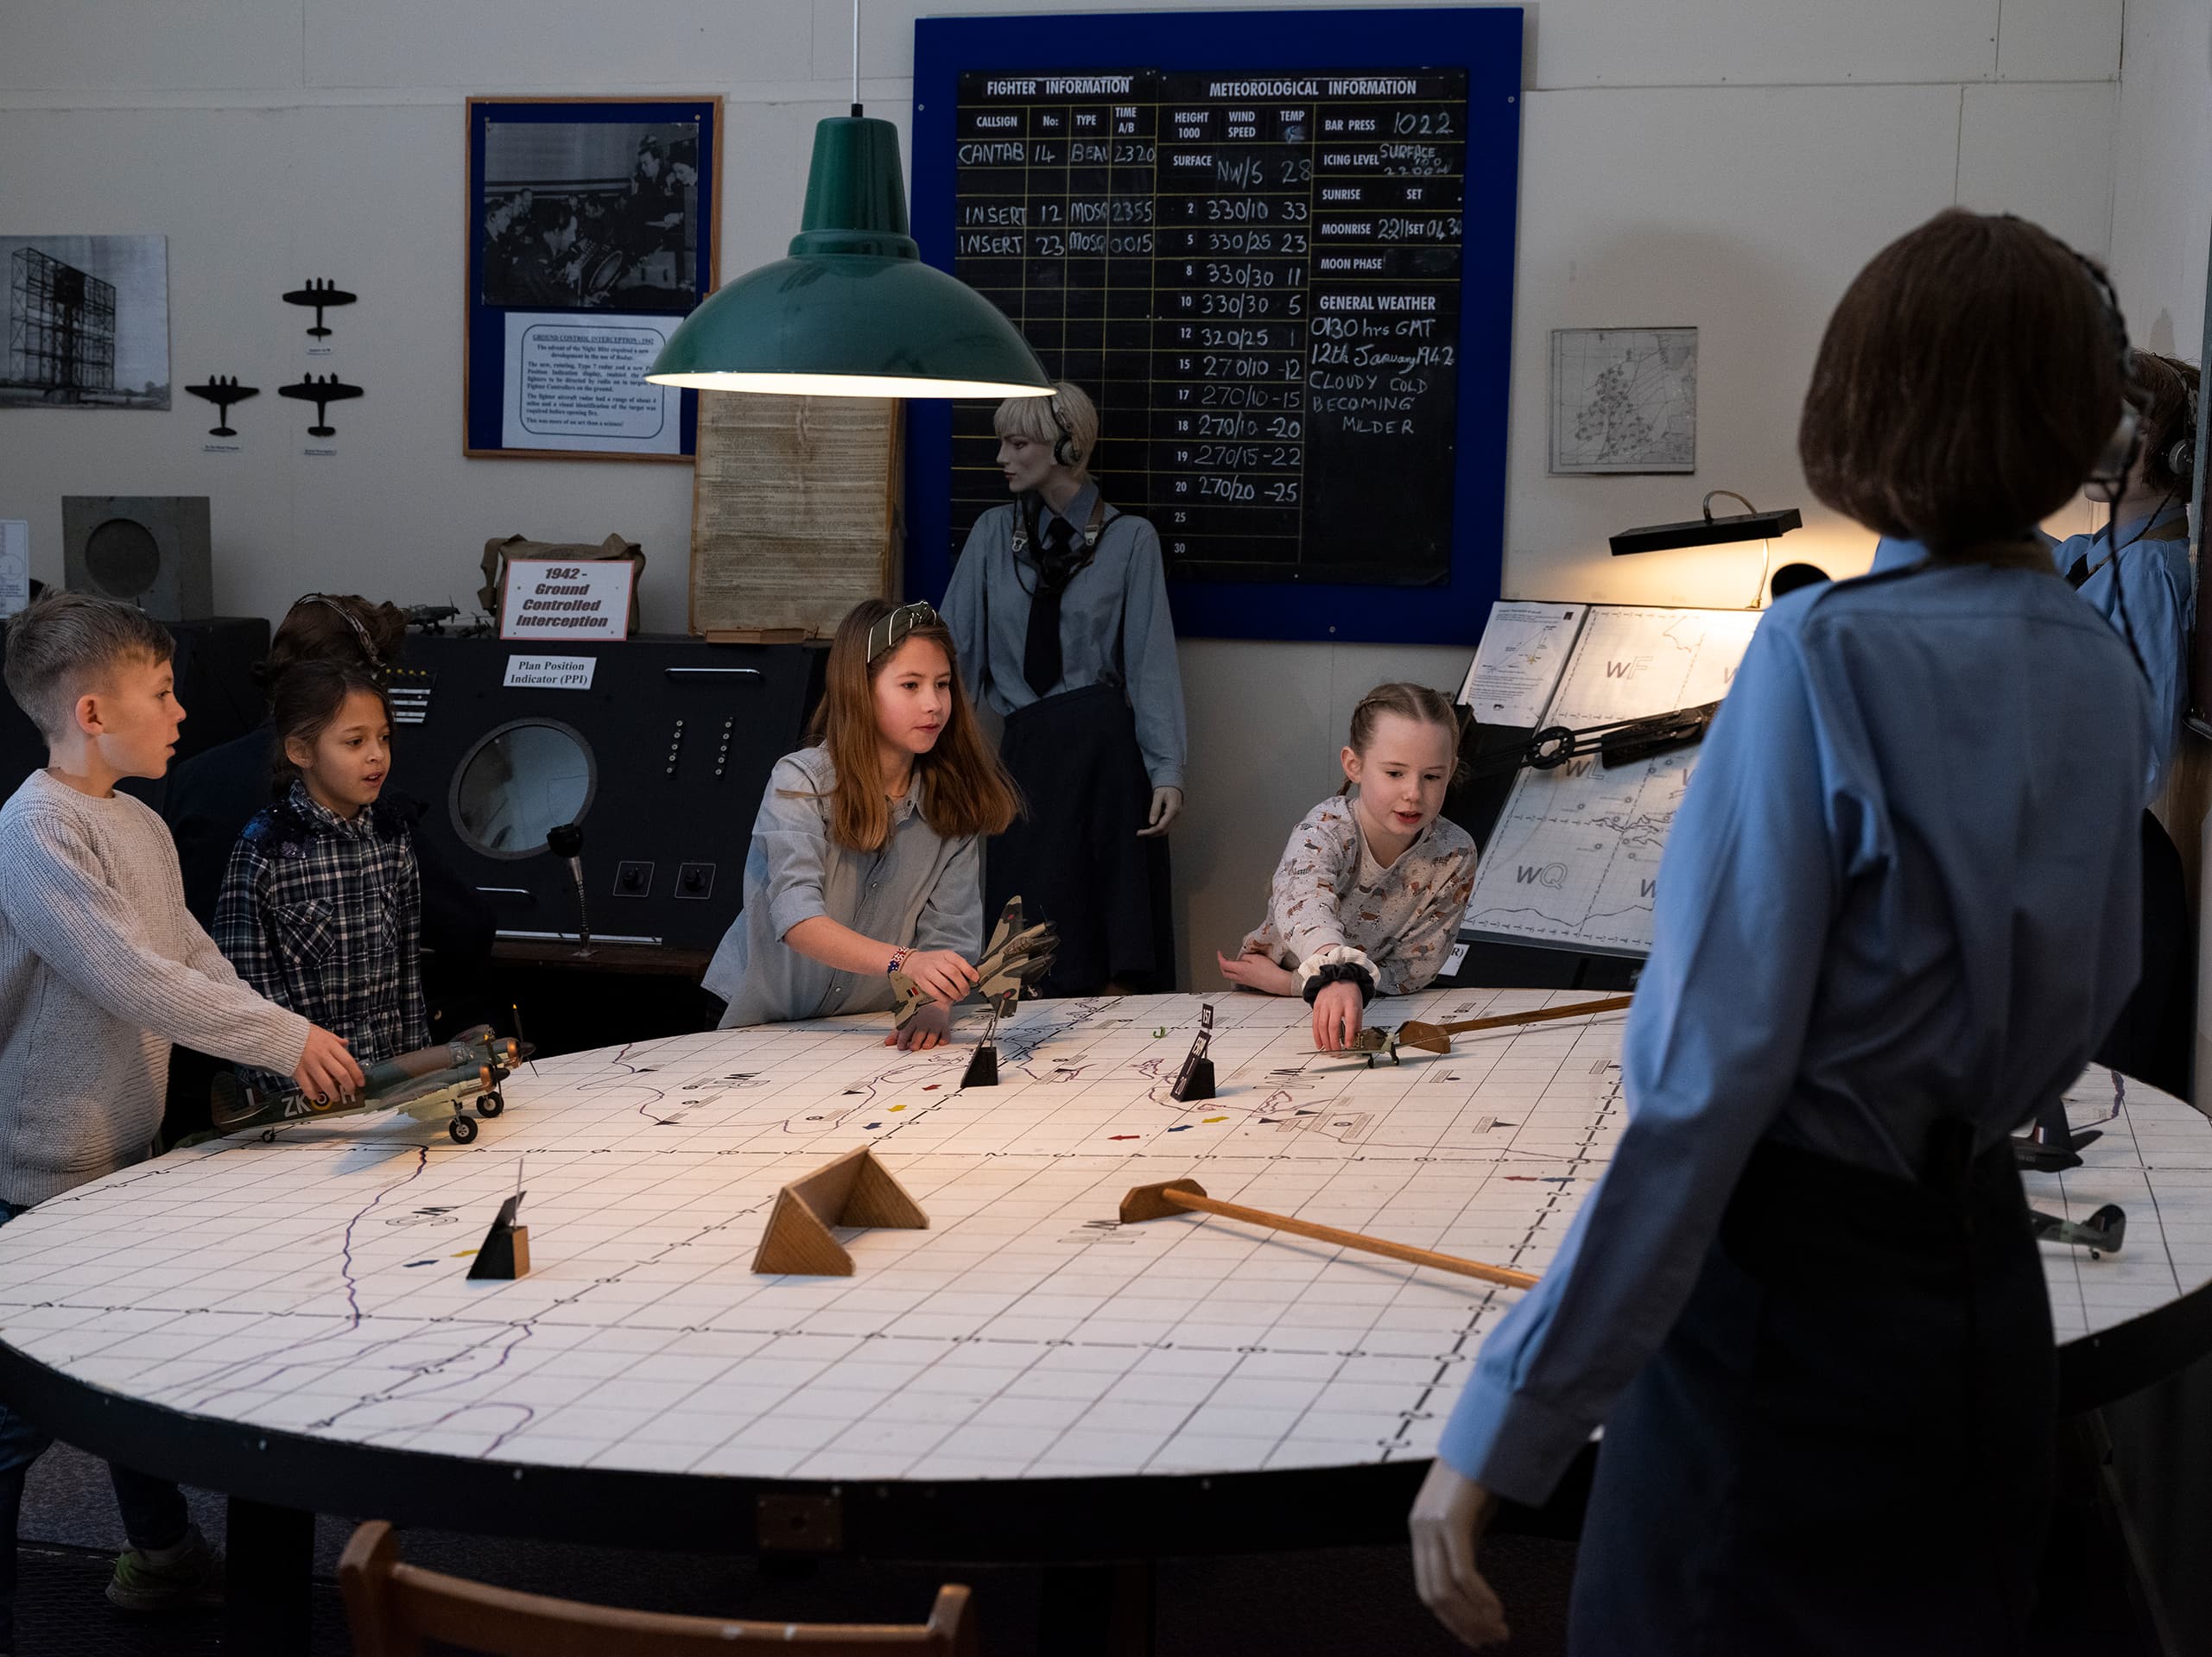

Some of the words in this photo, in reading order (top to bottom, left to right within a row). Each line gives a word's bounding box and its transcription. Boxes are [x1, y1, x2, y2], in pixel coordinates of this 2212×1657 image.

[987, 81, 1036, 95] FIGHTER
[1046, 79, 1130, 94] INFORMATION
[1209, 81, 1319, 97] METEOROLOGICAL
[1328, 80, 1417, 95] INFORMATION
[1115, 107, 1137, 118] TIME
[1175, 112, 1209, 123] HEIGHT
[1229, 111, 1255, 123] WIND
[1280, 111, 1305, 122] TEMP
[976, 117, 1017, 128] CALLSIGN
[1043, 116, 1059, 127] No:
[1076, 115, 1097, 126] TYPE
[1325, 119, 1343, 130] BAR
[1348, 119, 1375, 130] PRESS
[1394, 111, 1454, 134] 1022
[1118, 123, 1135, 134] A/B
[1178, 128, 1201, 139] 1000
[1228, 127, 1256, 138] SPEED
[959, 143, 1024, 165] CANTAB
[1035, 144, 1055, 163] 14
[1114, 145, 1155, 162] 2320
[1173, 155, 1212, 167] SURFACE
[1323, 155, 1351, 166] ICING
[1353, 155, 1379, 166] LEVEL
[1281, 159, 1312, 184] 28
[1322, 189, 1361, 200] SUNRISE
[1406, 189, 1423, 199] SET
[1041, 204, 1062, 223] 12
[1112, 200, 1153, 222] 2355
[1188, 203, 1194, 214] 2
[1282, 201, 1308, 220] 33
[965, 206, 1027, 226] INSERT
[1321, 224, 1371, 235] MOONRISE
[1409, 224, 1424, 234] SET
[960, 235, 1023, 254] INSERT
[1110, 234, 1153, 253] 0015
[1188, 234, 1194, 244] 5
[1281, 233, 1307, 253] 23
[1036, 236, 1065, 256] 23
[1186, 265, 1192, 275] 8
[1321, 259, 1350, 270] MOON
[1353, 259, 1382, 269] PHASE
[1181, 296, 1192, 307] 10
[1288, 294, 1301, 315] 5
[1320, 296, 1374, 310] GENERAL
[1378, 296, 1436, 310] WEATHER
[1181, 328, 1191, 338] 12
[1362, 318, 1390, 338] hrs
[1395, 319, 1436, 338] GMT
[1311, 342, 1349, 365] 12th
[1353, 344, 1417, 374] January
[1180, 359, 1190, 370] 15
[1309, 371, 1378, 389] CLOUDY
[1390, 377, 1428, 394] COLD
[1178, 389, 1188, 401] 17
[1313, 396, 1416, 413] BECOMING
[1178, 421, 1188, 431] 18
[1342, 416, 1415, 434] MILDER
[1177, 451, 1188, 462] 19
[1176, 481, 1187, 492] 20
[1175, 512, 1186, 522] 25
[1174, 543, 1186, 553] 30
[545, 567, 580, 579] 1942
[535, 584, 591, 596] Ground
[522, 599, 602, 611] Controlled
[516, 615, 608, 629] Interception
[518, 661, 541, 671] Plan
[544, 661, 585, 671] Position
[510, 674, 558, 685] Indicator
[560, 674, 587, 686] (PPI)
[1516, 862, 1568, 890] WQ
[282, 1093, 311, 1117] ZK
